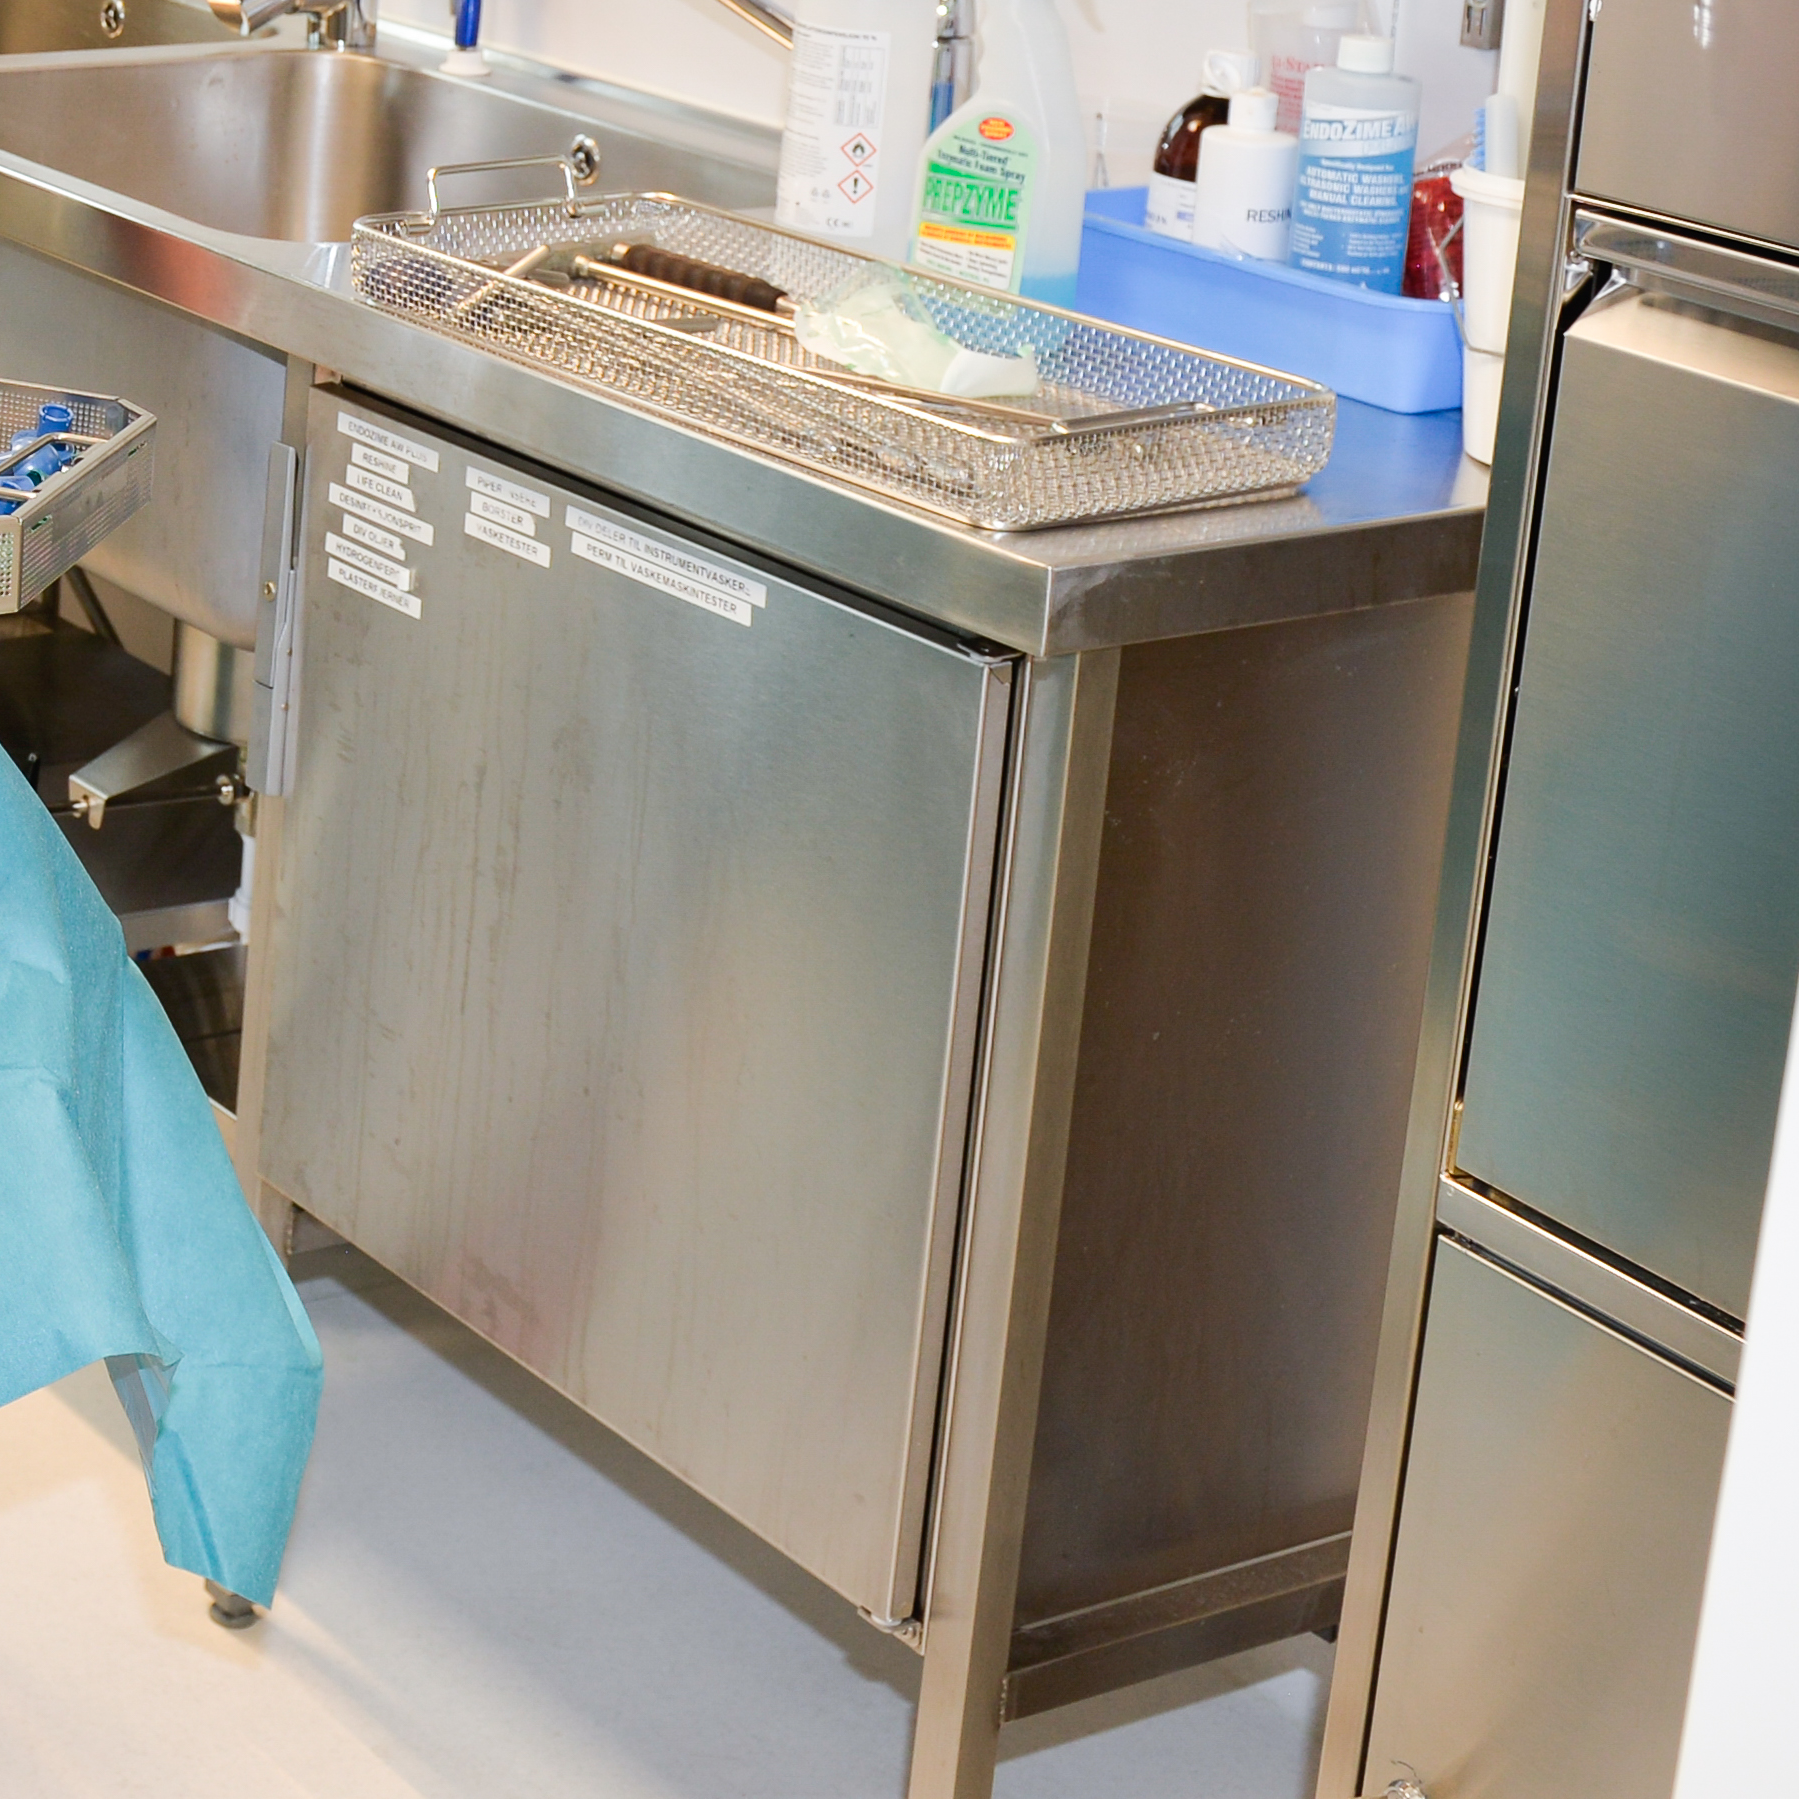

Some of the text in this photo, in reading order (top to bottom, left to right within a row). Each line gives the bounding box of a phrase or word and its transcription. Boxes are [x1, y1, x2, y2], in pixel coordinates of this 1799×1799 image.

[922, 176, 1019, 221] PREPZYME
[362, 452, 397, 475] RESHINE
[357, 474, 403, 501] LIFE CLEAN
[353, 523, 367, 539] DIV
[595, 520, 626, 545] DELER
[629, 532, 641, 550] TIL
[587, 543, 737, 614] PERM TIL VASKEMASKINTESTER
